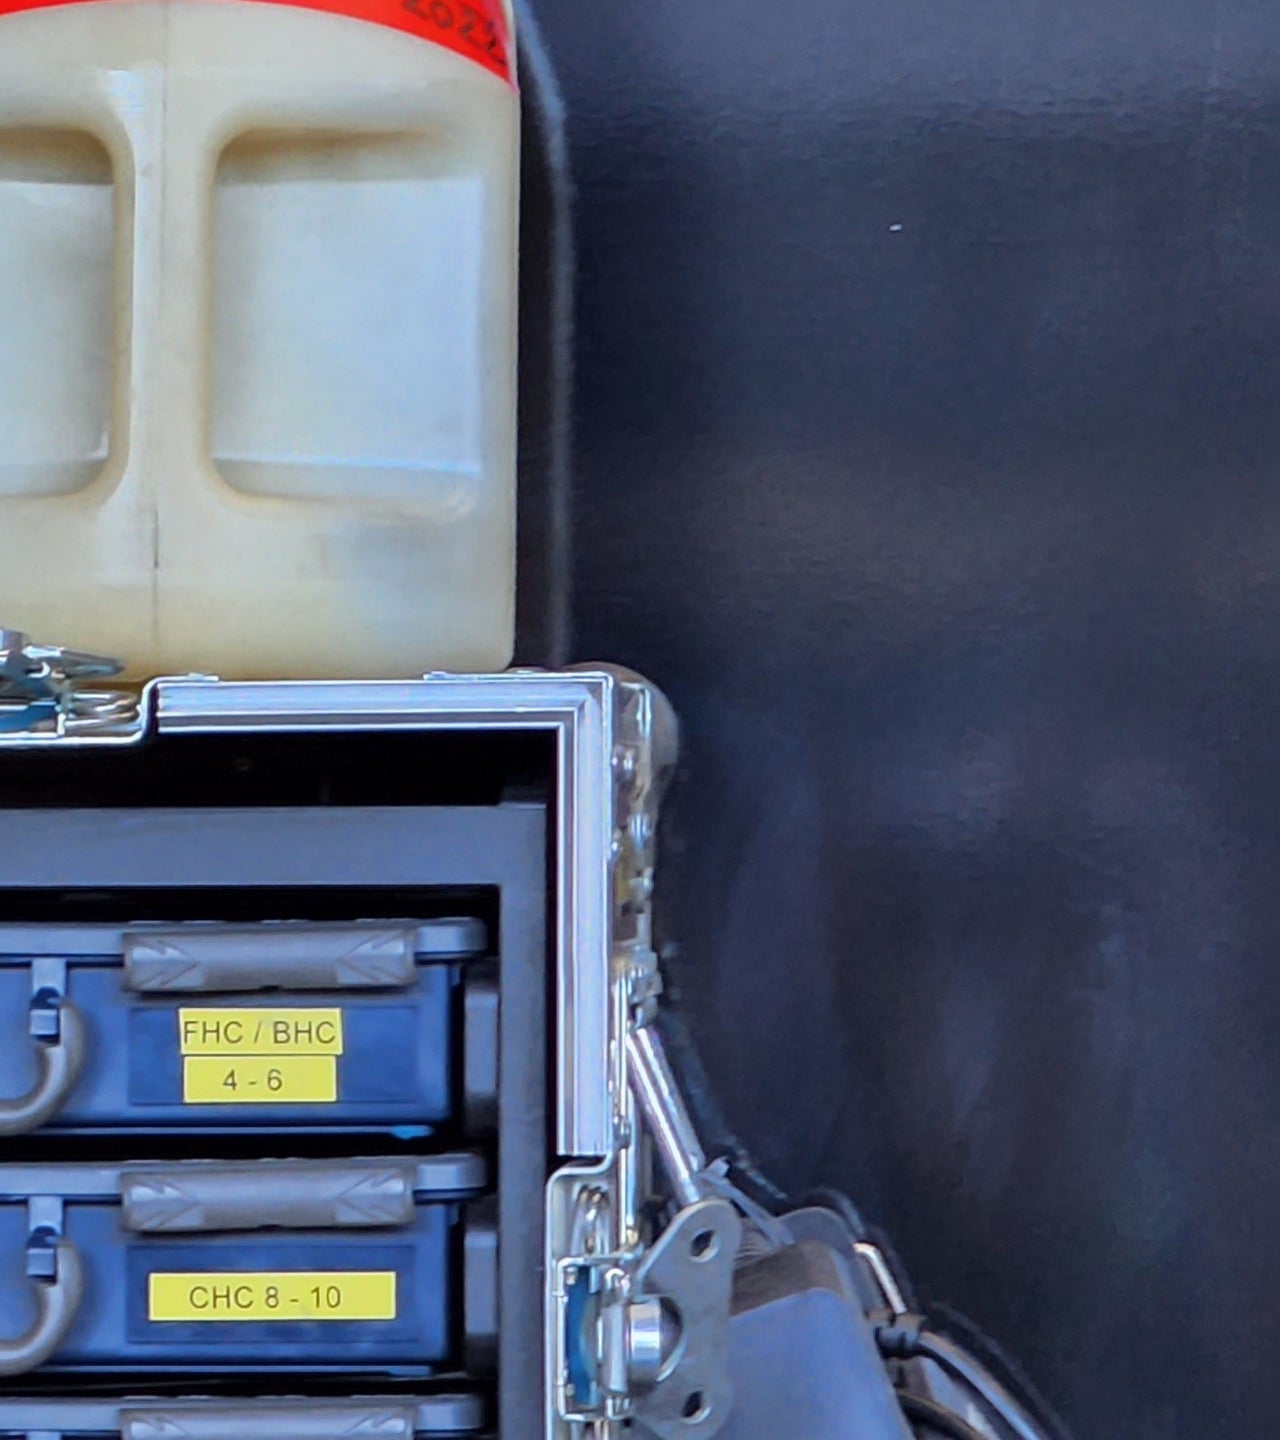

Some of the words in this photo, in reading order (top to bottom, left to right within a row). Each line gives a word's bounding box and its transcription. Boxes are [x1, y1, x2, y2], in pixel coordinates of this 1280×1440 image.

[182, 1020, 244, 1044] FHC
[272, 1020, 337, 1044] BHC
[222, 1068, 238, 1091] 4
[266, 1068, 283, 1091] 6
[189, 1285, 254, 1309] CHC
[264, 1286, 280, 1309] 8
[310, 1286, 341, 1309] 10
